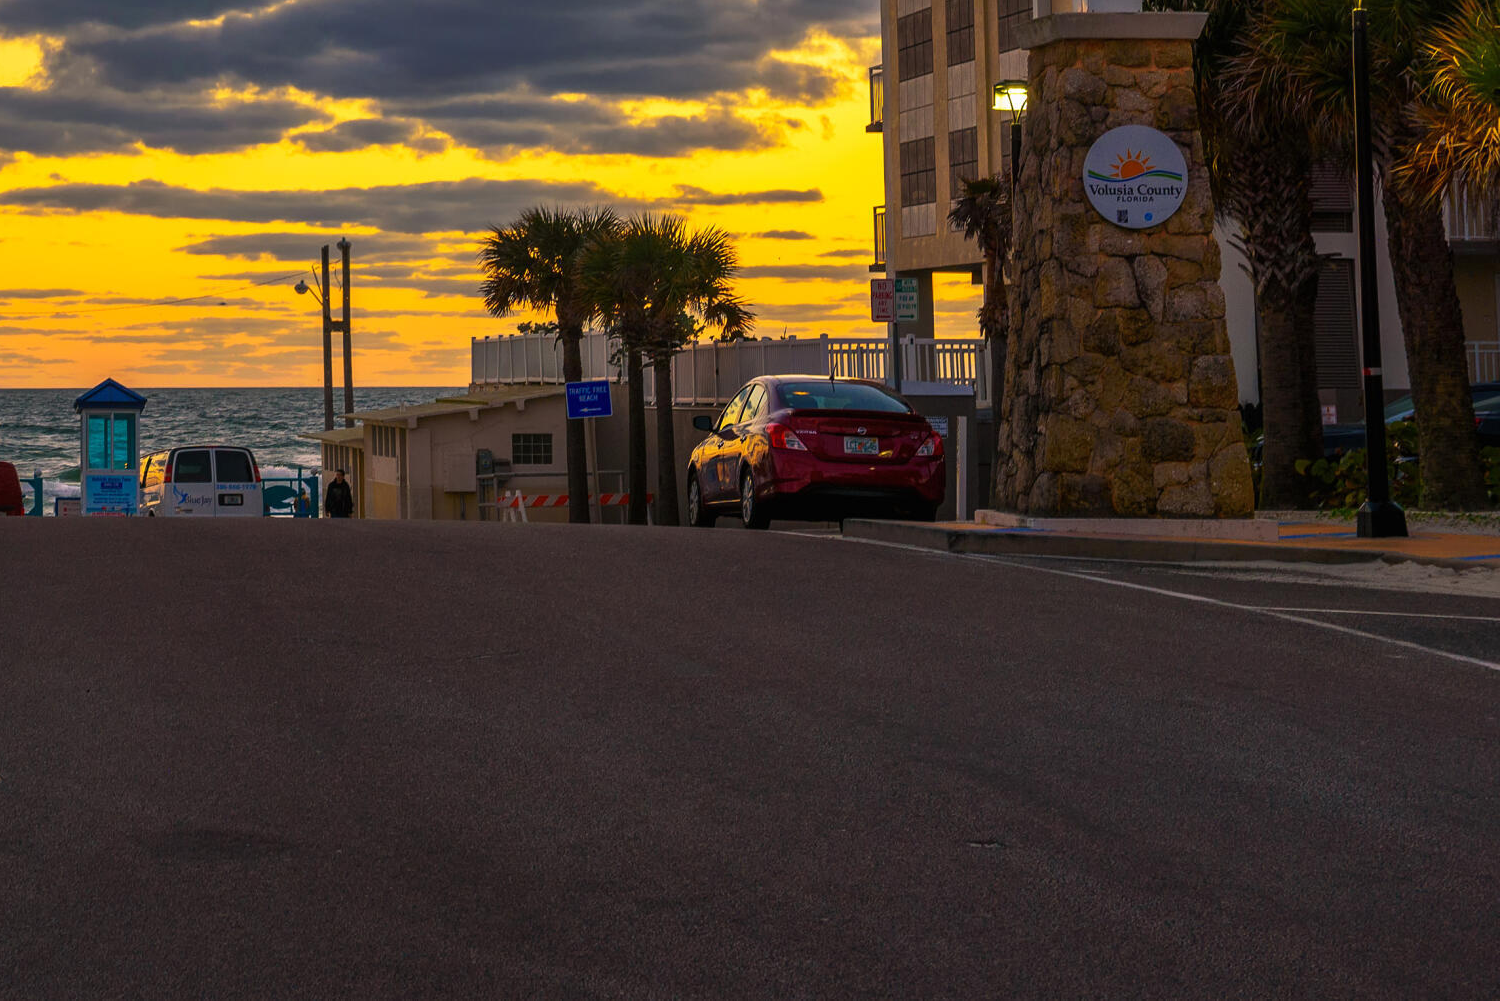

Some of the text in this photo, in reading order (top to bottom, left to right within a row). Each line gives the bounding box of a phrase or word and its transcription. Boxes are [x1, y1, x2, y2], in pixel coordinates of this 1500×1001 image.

[1089, 183, 1182, 200] Volusia County
[593, 385, 607, 393] FREE
[579, 394, 599, 402] BEACH
